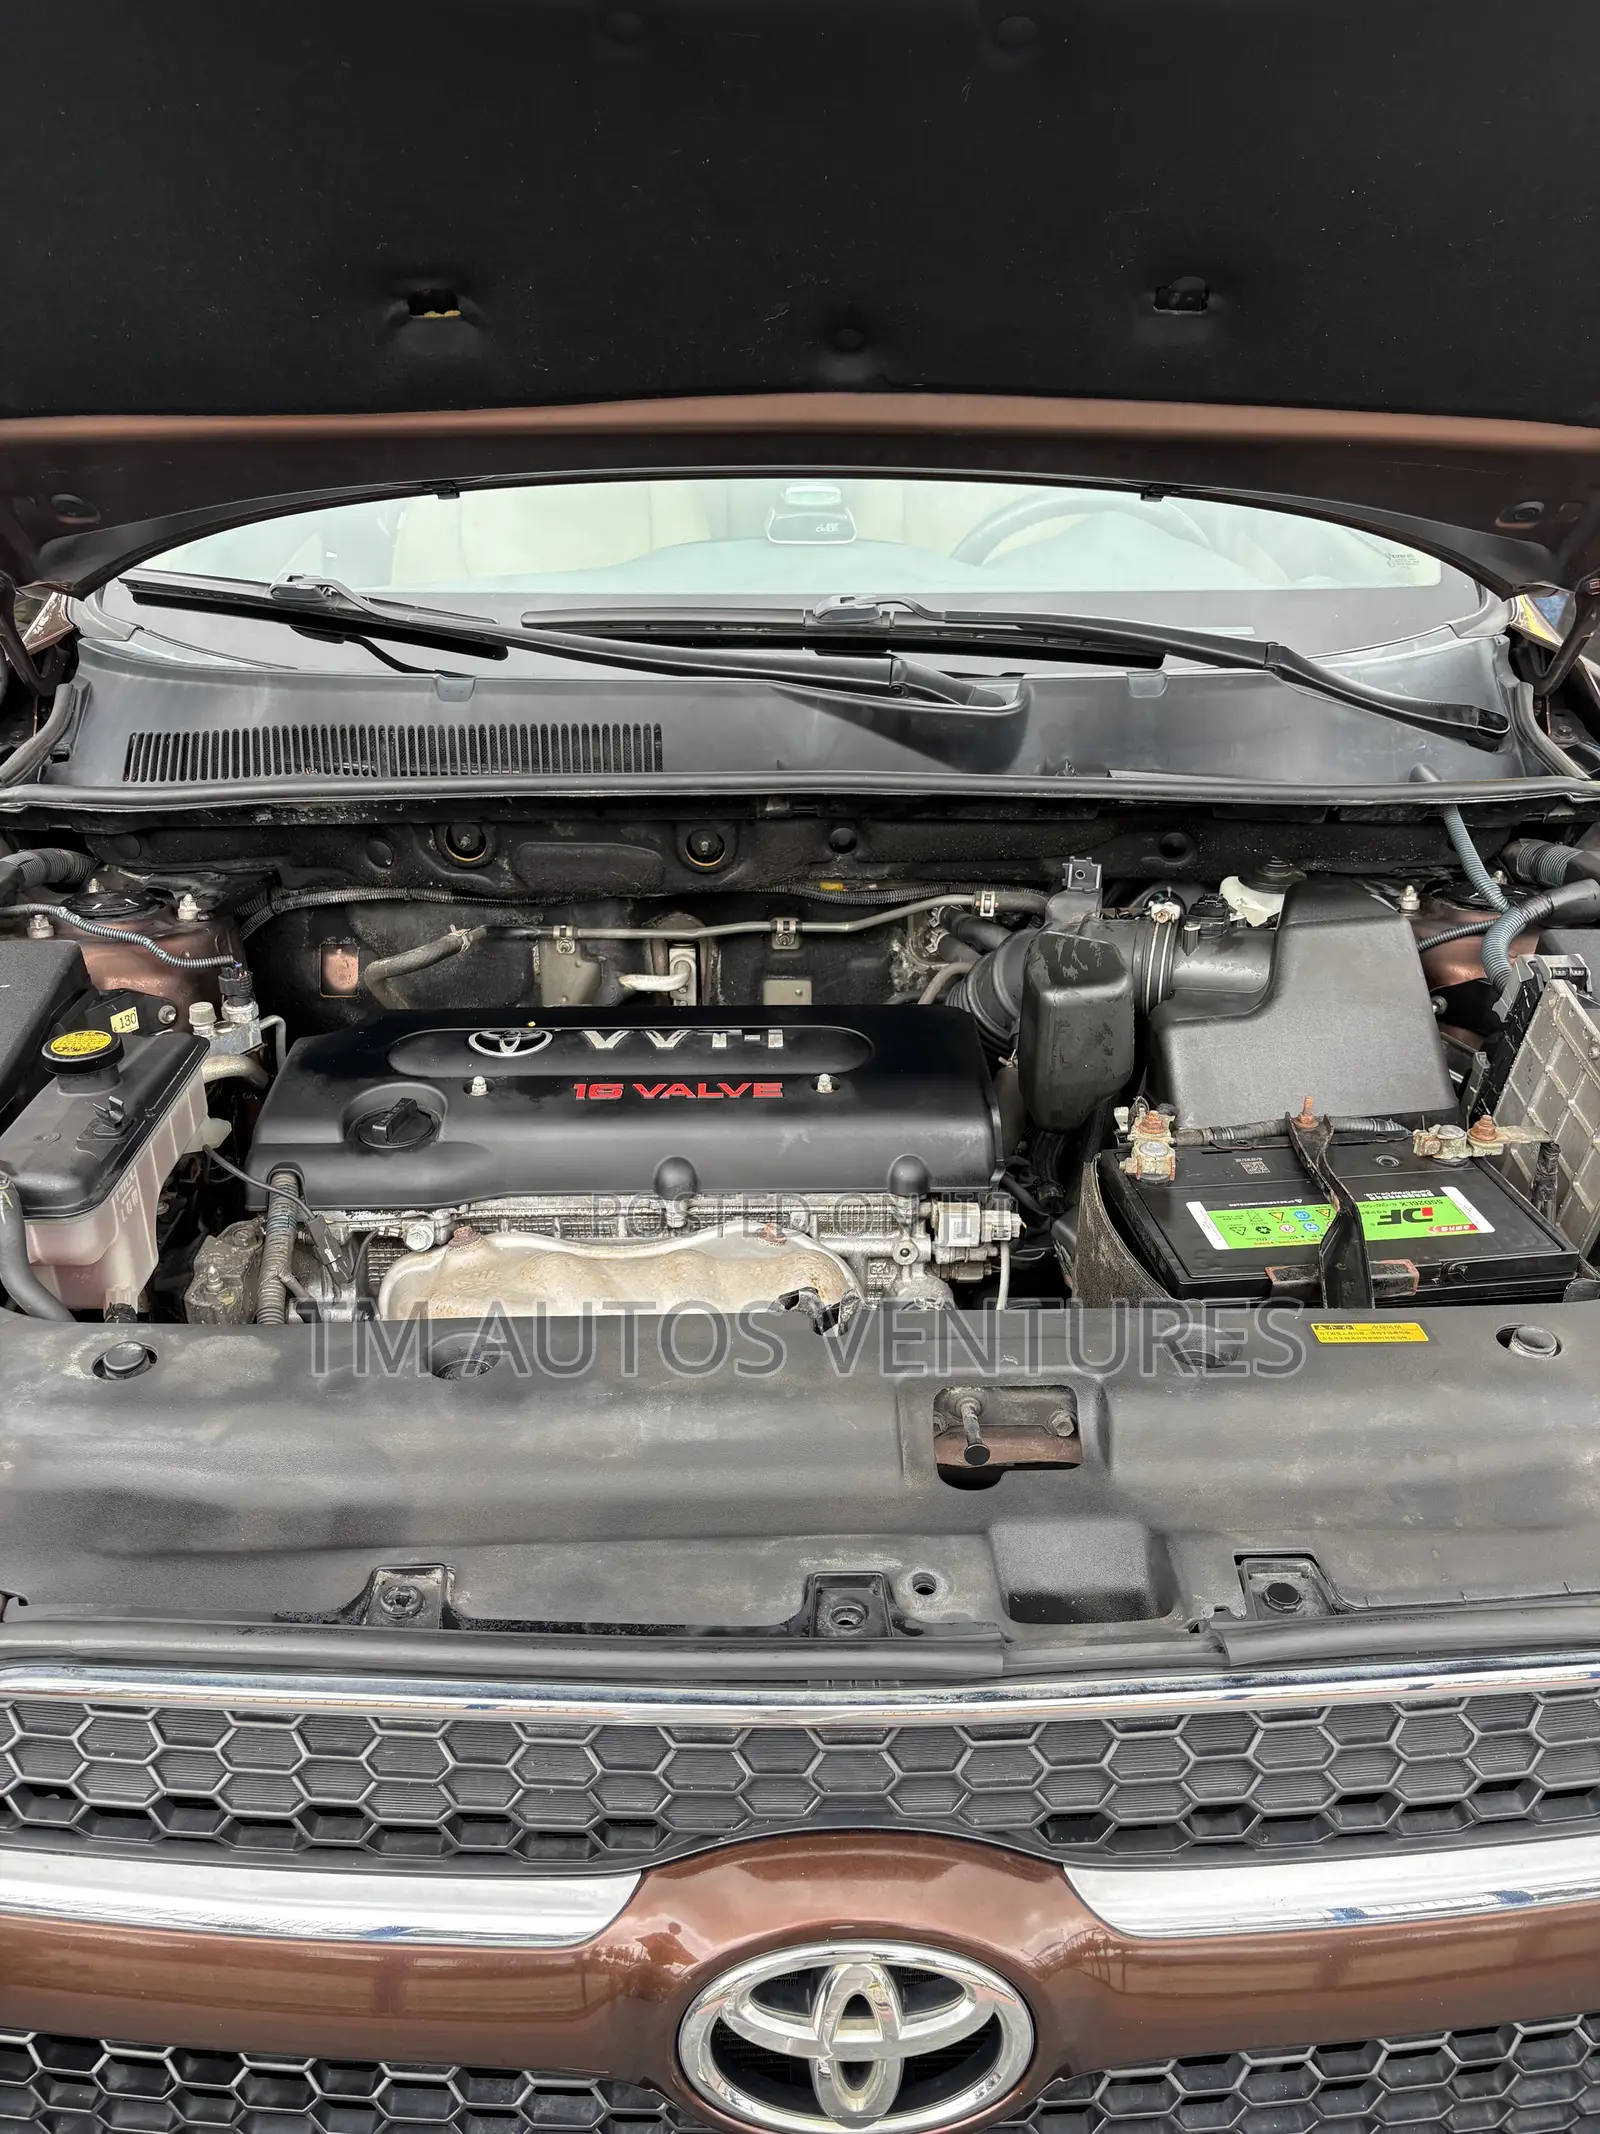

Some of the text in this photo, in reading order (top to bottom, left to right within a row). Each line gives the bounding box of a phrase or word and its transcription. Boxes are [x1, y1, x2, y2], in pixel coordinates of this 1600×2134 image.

[119, 1012, 137, 1030] 130
[573, 1082, 784, 1100] 16 VALVE
